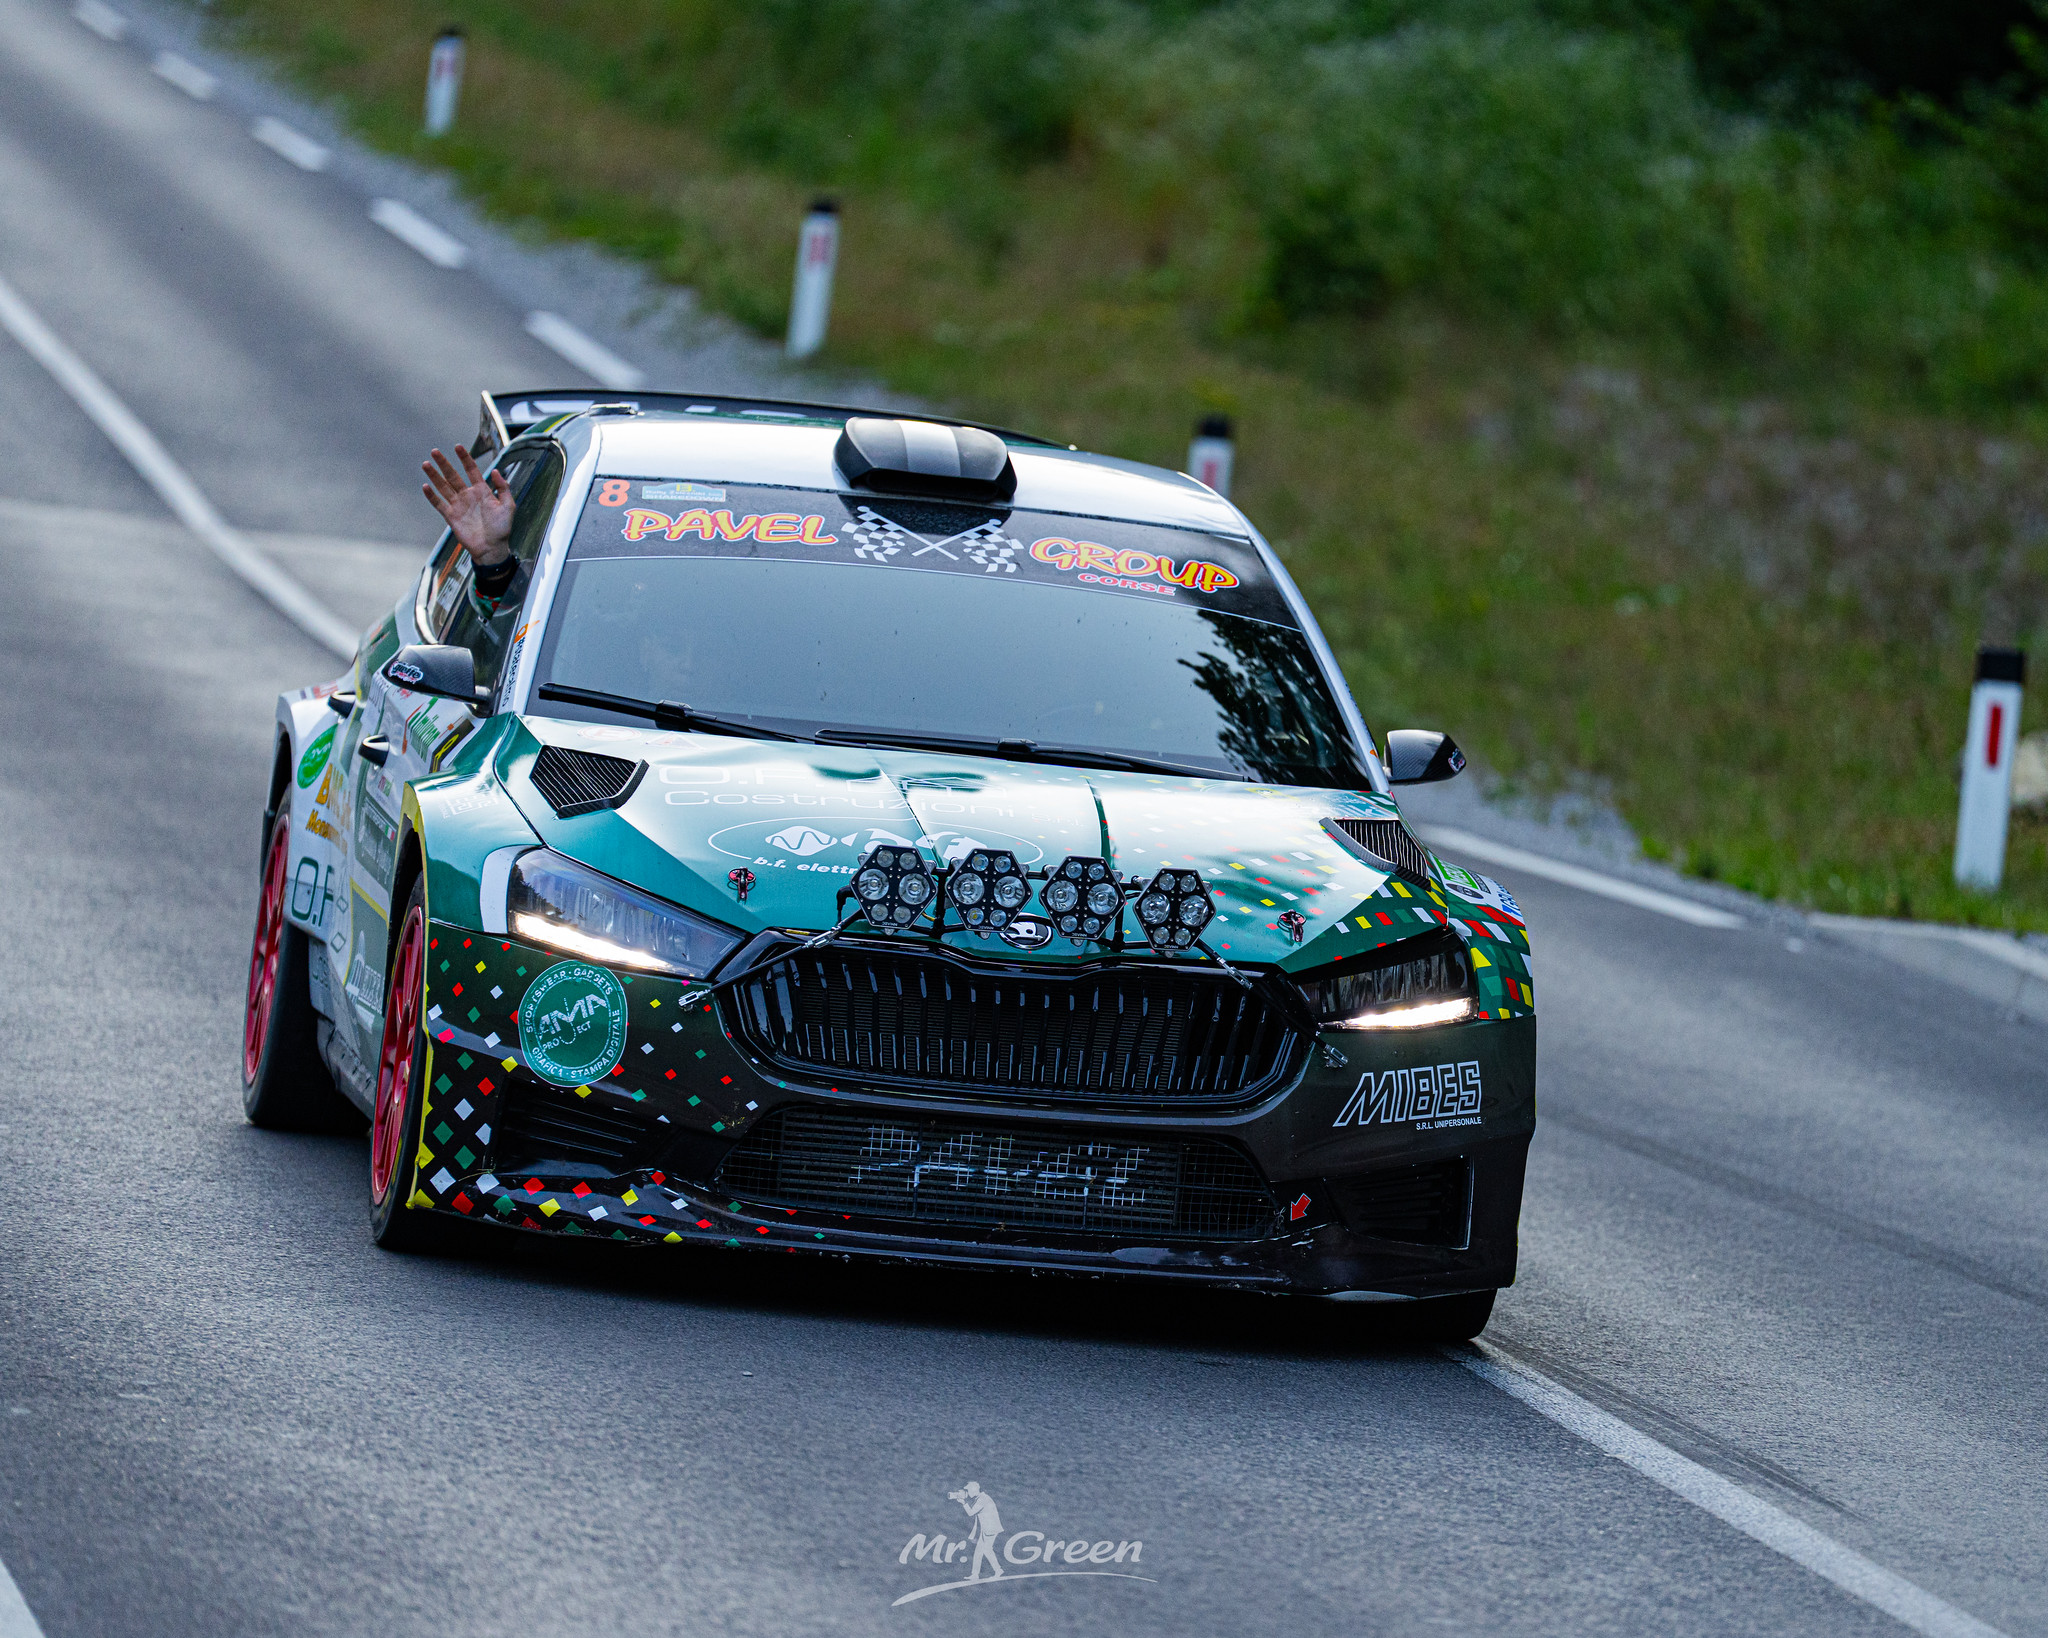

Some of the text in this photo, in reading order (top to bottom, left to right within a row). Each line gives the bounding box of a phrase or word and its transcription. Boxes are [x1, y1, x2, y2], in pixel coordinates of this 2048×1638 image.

[598, 479, 631, 507] 8
[621, 508, 1240, 593] PAVEL GROUP
[1078, 573, 1176, 596] CORSE
[664, 790, 1015, 818] Costruzioni
[753, 857, 858, 875] b.f. elettr
[573, 967, 614, 996] GADGETS
[570, 1056, 610, 1079] STAMPA
[605, 1009, 621, 1058] DIGITALE
[1332, 1060, 1483, 1128] MIBES
[1416, 1116, 1482, 1131] S.R.L. UNIPERSONALE
